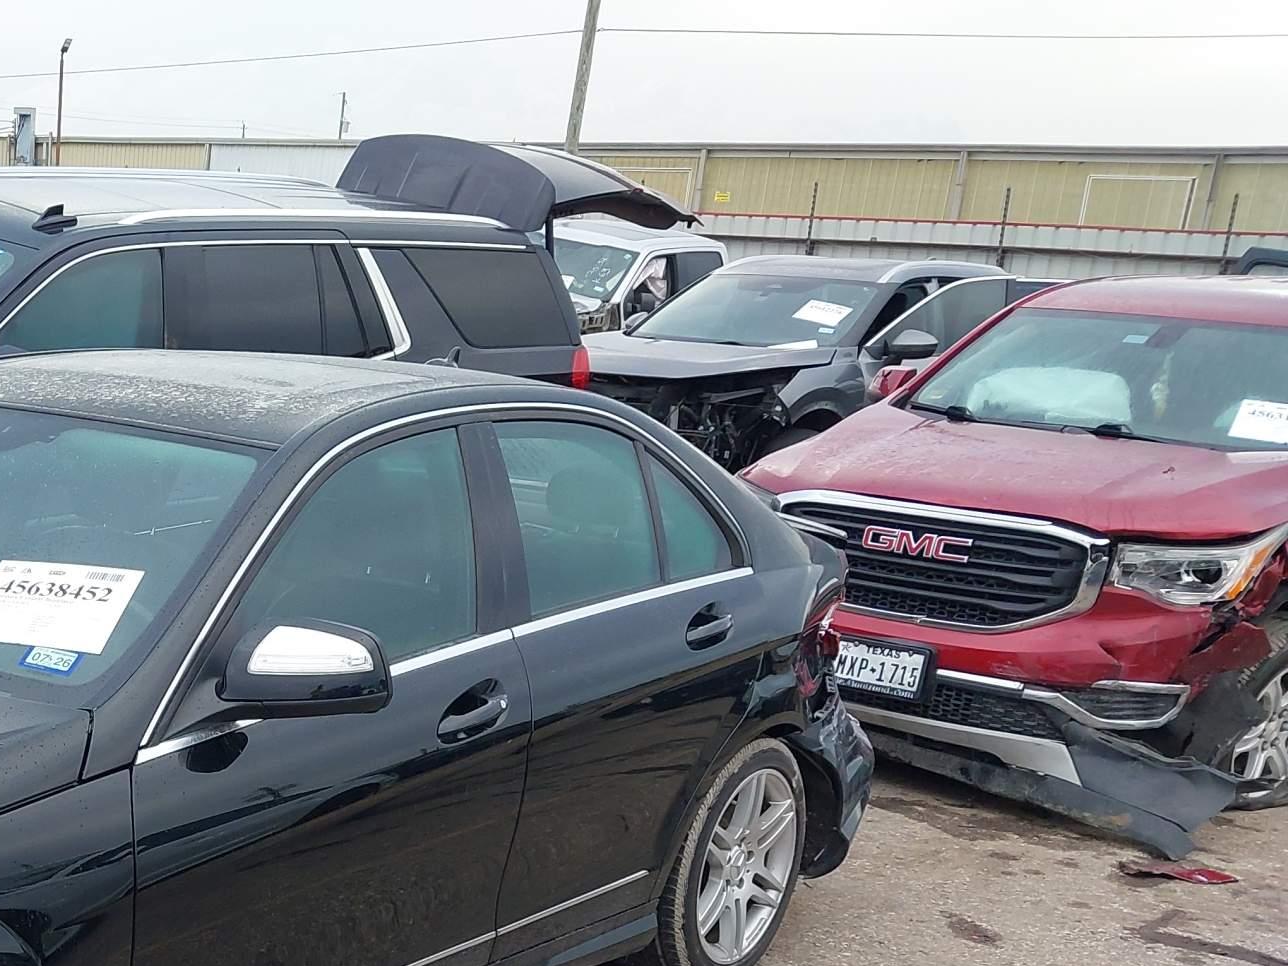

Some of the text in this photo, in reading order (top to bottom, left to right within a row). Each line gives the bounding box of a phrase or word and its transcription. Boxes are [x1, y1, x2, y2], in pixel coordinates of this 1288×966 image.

[1247, 408, 1288, 421] 4563
[861, 525, 974, 563] GMC
[0, 579, 113, 603] 45638452
[866, 645, 901, 659] TEXAS
